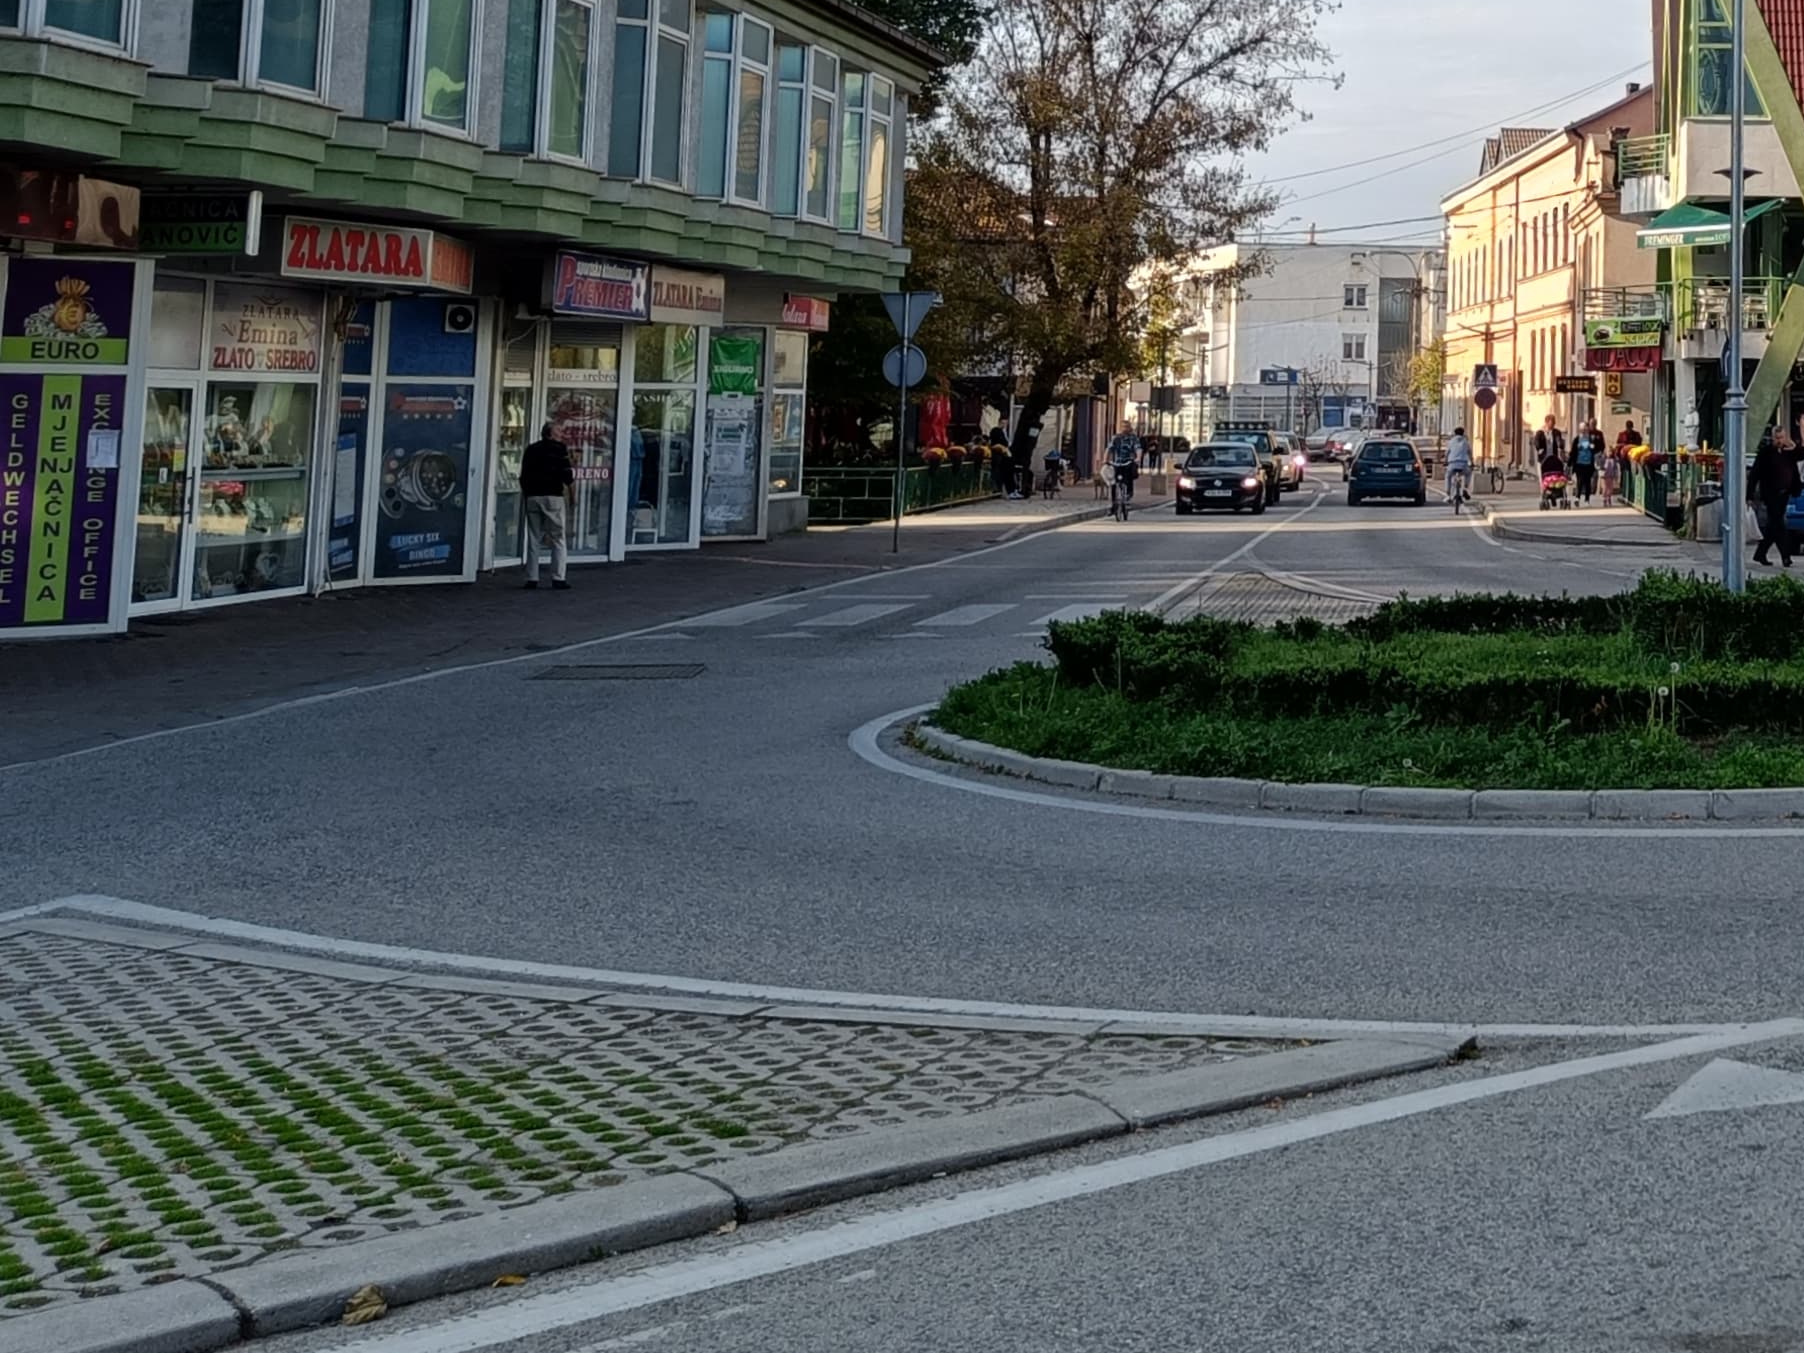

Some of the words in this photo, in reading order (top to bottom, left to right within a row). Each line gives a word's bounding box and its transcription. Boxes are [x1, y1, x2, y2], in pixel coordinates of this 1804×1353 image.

[140, 223, 237, 245] ANOVIĆ
[287, 223, 423, 277] ZLATARA
[555, 255, 633, 312] PREMIER
[653, 281, 694, 309] ZLATARA
[237, 319, 298, 345] Emina
[242, 304, 299, 320] ZLATARA
[31, 341, 99, 360] EURO
[213, 346, 255, 369] ZLATO
[265, 348, 316, 370] SREBRO
[86, 394, 112, 502] EXCGE
[0, 393, 29, 604] GELDWECHSEL
[37, 394, 74, 601] MJENJAČNICA
[79, 518, 104, 600] OFFICE
